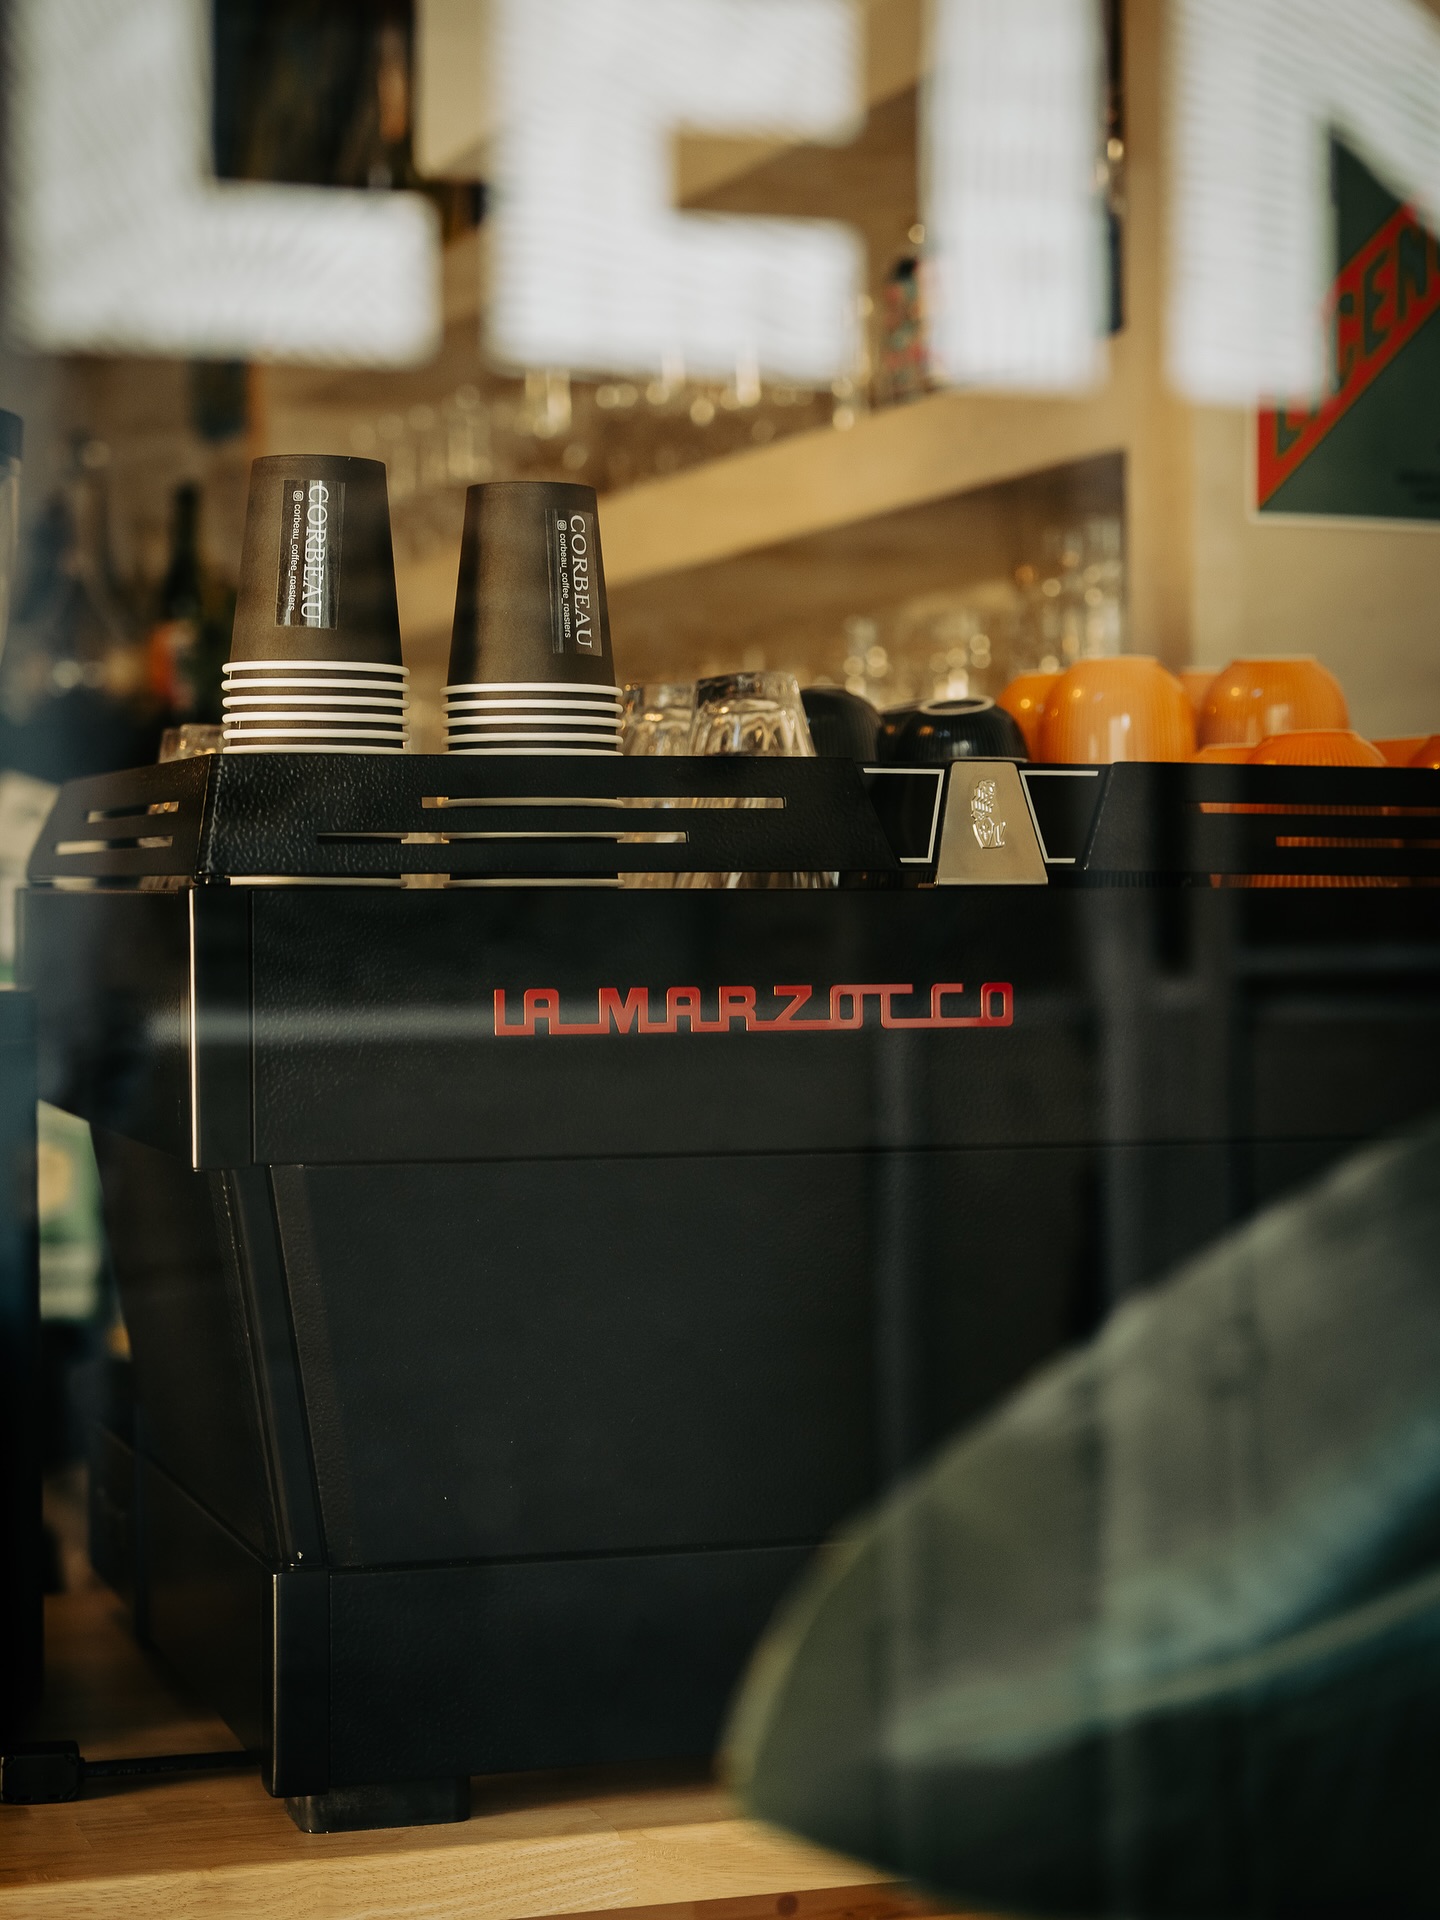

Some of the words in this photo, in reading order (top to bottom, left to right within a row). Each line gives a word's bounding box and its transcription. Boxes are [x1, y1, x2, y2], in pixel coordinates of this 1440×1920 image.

[287, 503, 302, 611] corbeau_coffee_roasters
[301, 485, 329, 619] CORBEAU
[559, 533, 571, 638] corbeau_coffee_roasters
[570, 514, 593, 648] CORBEAU
[494, 988, 560, 1036] LA
